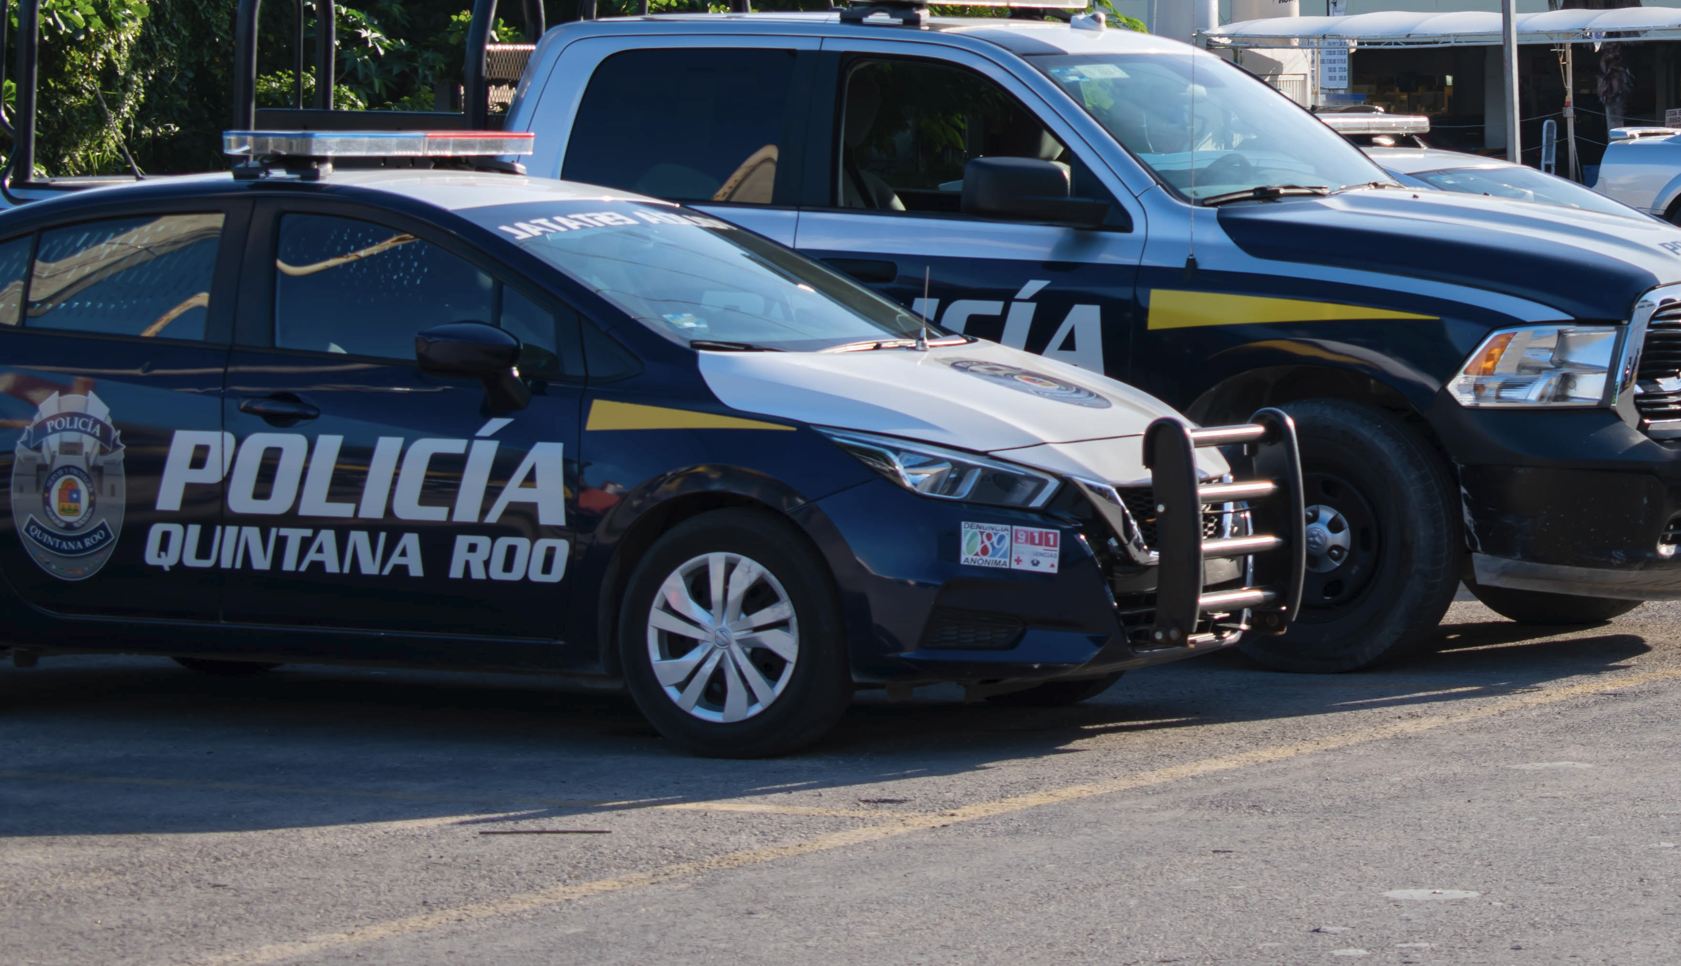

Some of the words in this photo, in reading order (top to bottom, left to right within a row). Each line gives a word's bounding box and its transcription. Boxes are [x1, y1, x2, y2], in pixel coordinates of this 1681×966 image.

[47, 416, 101, 437] POLICÍA
[155, 417, 567, 526] POLICÍA
[29, 524, 83, 551] QUINTANA
[84, 529, 106, 547] ROO
[1017, 530, 1055, 546] 911
[144, 522, 425, 577] QUINTANA
[448, 534, 570, 583] ROO
